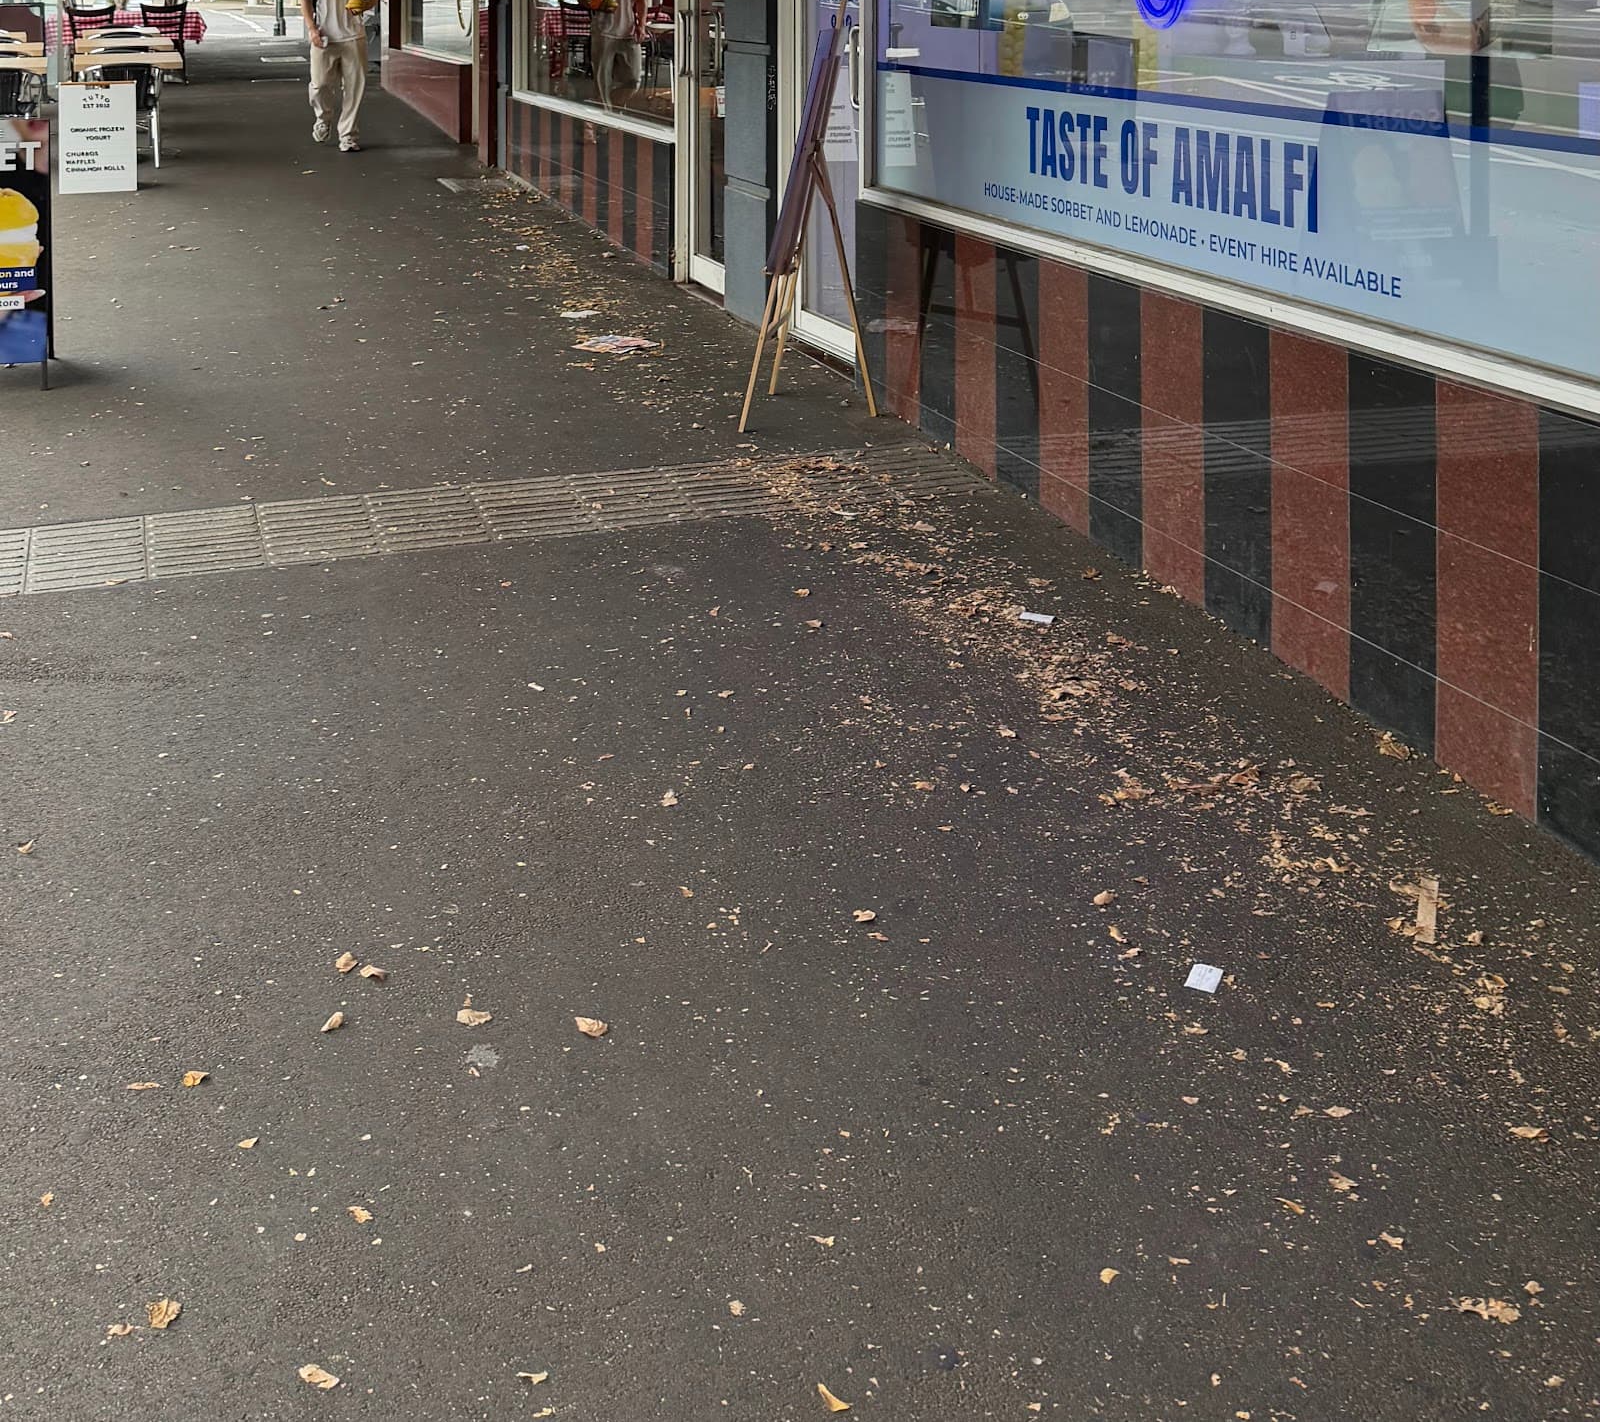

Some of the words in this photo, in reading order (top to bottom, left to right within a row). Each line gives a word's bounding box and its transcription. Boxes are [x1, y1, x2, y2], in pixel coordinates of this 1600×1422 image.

[1026, 106, 1108, 189] TASTE
[1120, 119, 1159, 198] OF
[1171, 127, 1318, 233] AMALFI
[14, 268, 34, 277] and
[984, 182, 1048, 211] HOUSE-MADE
[1051, 197, 1093, 221] SORBET
[1095, 208, 1121, 228] AND
[1125, 214, 1197, 247] LEMONADE
[1209, 234, 1257, 262] EVENT
[1261, 246, 1299, 273] HIRE
[1302, 257, 1402, 298] AVAILABLE
